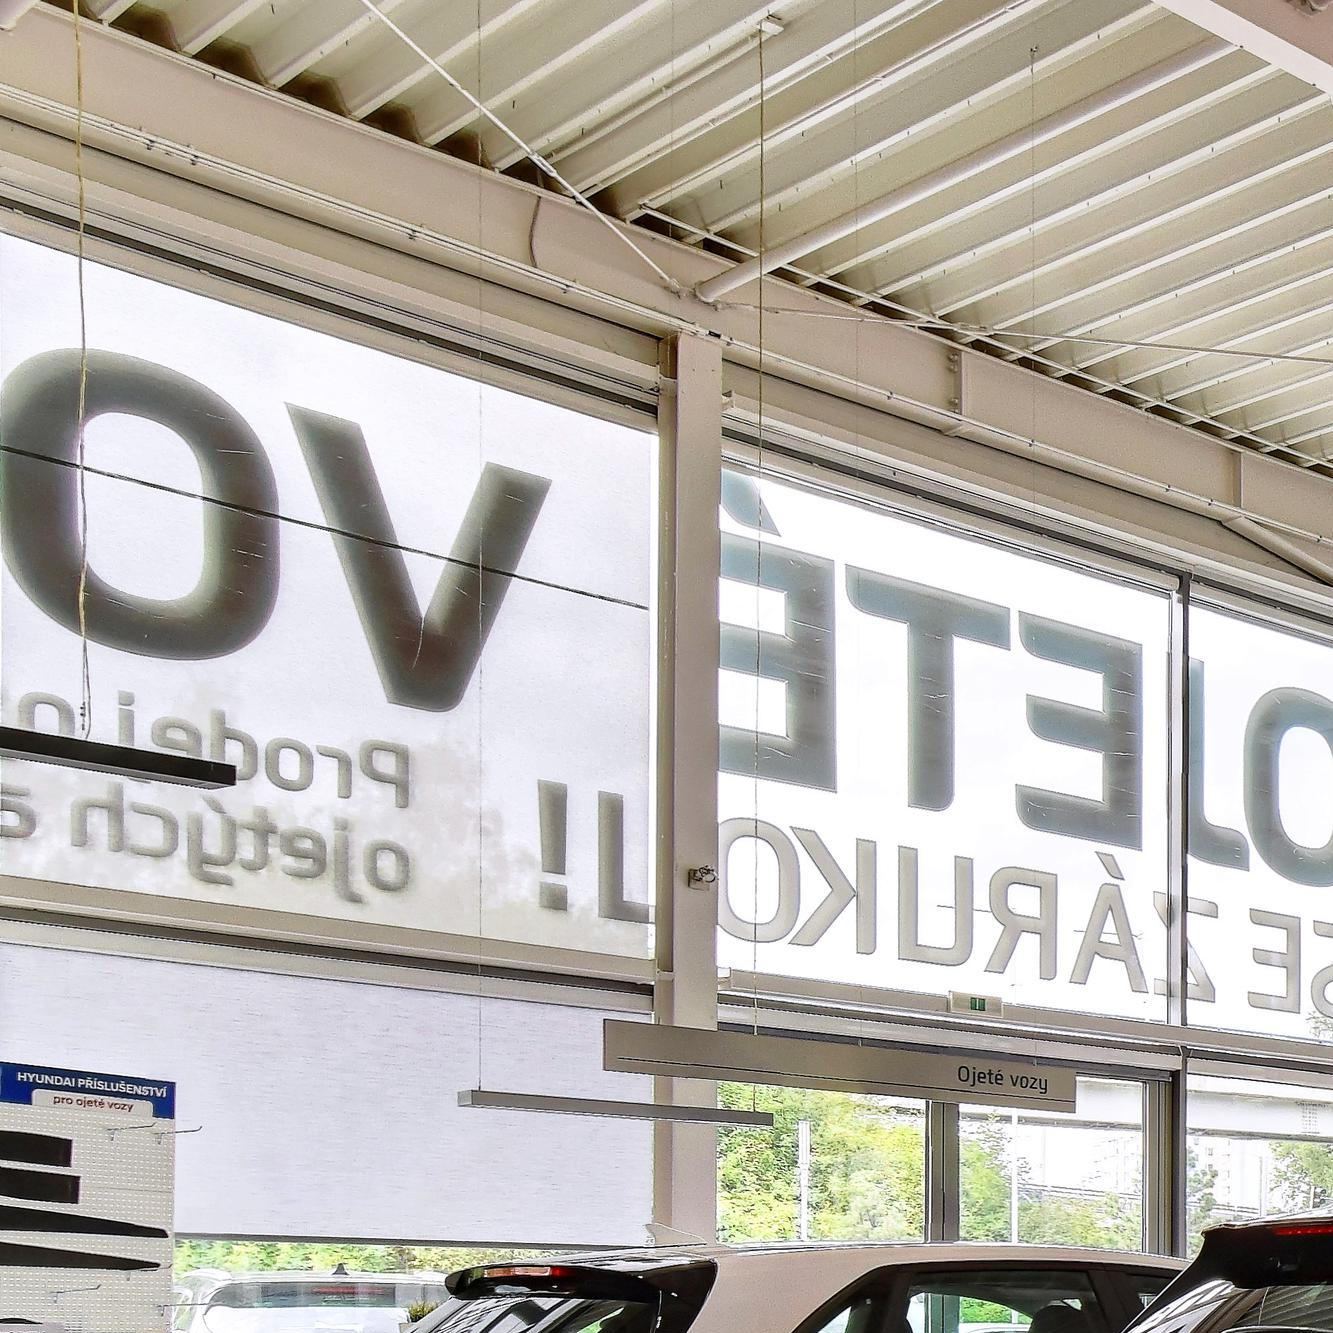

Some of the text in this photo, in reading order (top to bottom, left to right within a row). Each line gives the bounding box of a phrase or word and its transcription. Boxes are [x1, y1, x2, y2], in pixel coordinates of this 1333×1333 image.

[17, 1072, 168, 1098] HYUNDAI PŘÍSLUŠENSTVÍ
[957, 1065, 1048, 1094] Ojeté vozy
[53, 1095, 74, 1105] pro
[108, 1101, 134, 1113] vozy
